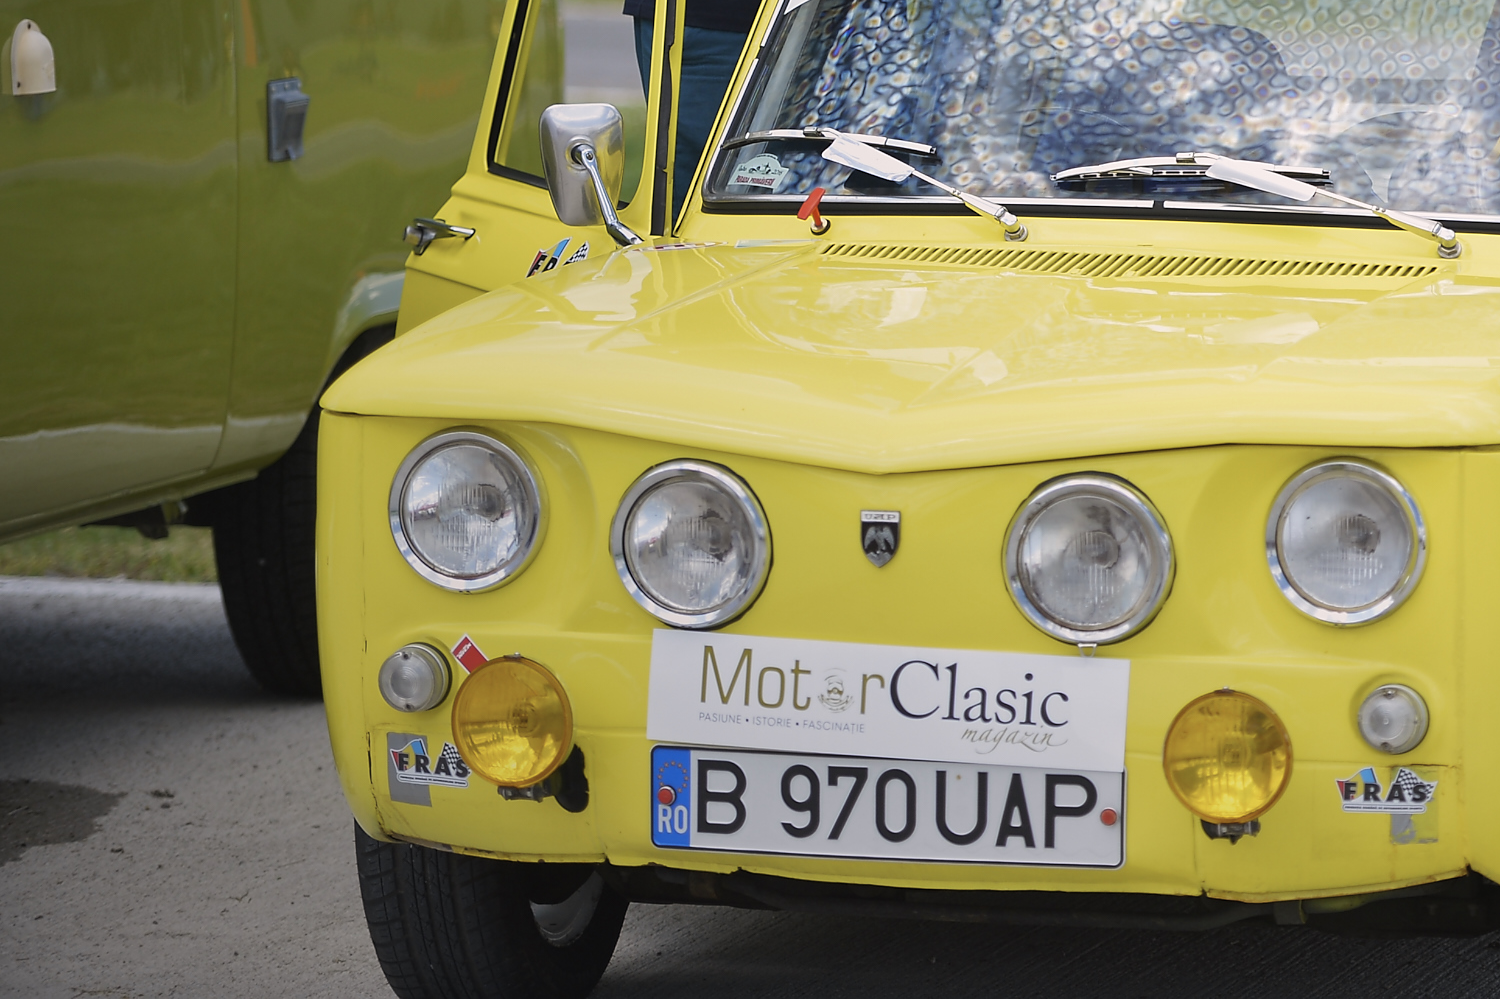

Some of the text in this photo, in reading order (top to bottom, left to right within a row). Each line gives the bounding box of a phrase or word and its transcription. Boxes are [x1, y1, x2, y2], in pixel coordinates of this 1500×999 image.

[698, 712, 742, 724] PASIUNE
[752, 715, 792, 728] ISTORIE
[961, 725, 1068, 754] magazin
[398, 752, 470, 779] FRAS
[658, 804, 688, 835] RO
[697, 759, 748, 835] B
[1343, 782, 1428, 804] FRAS
